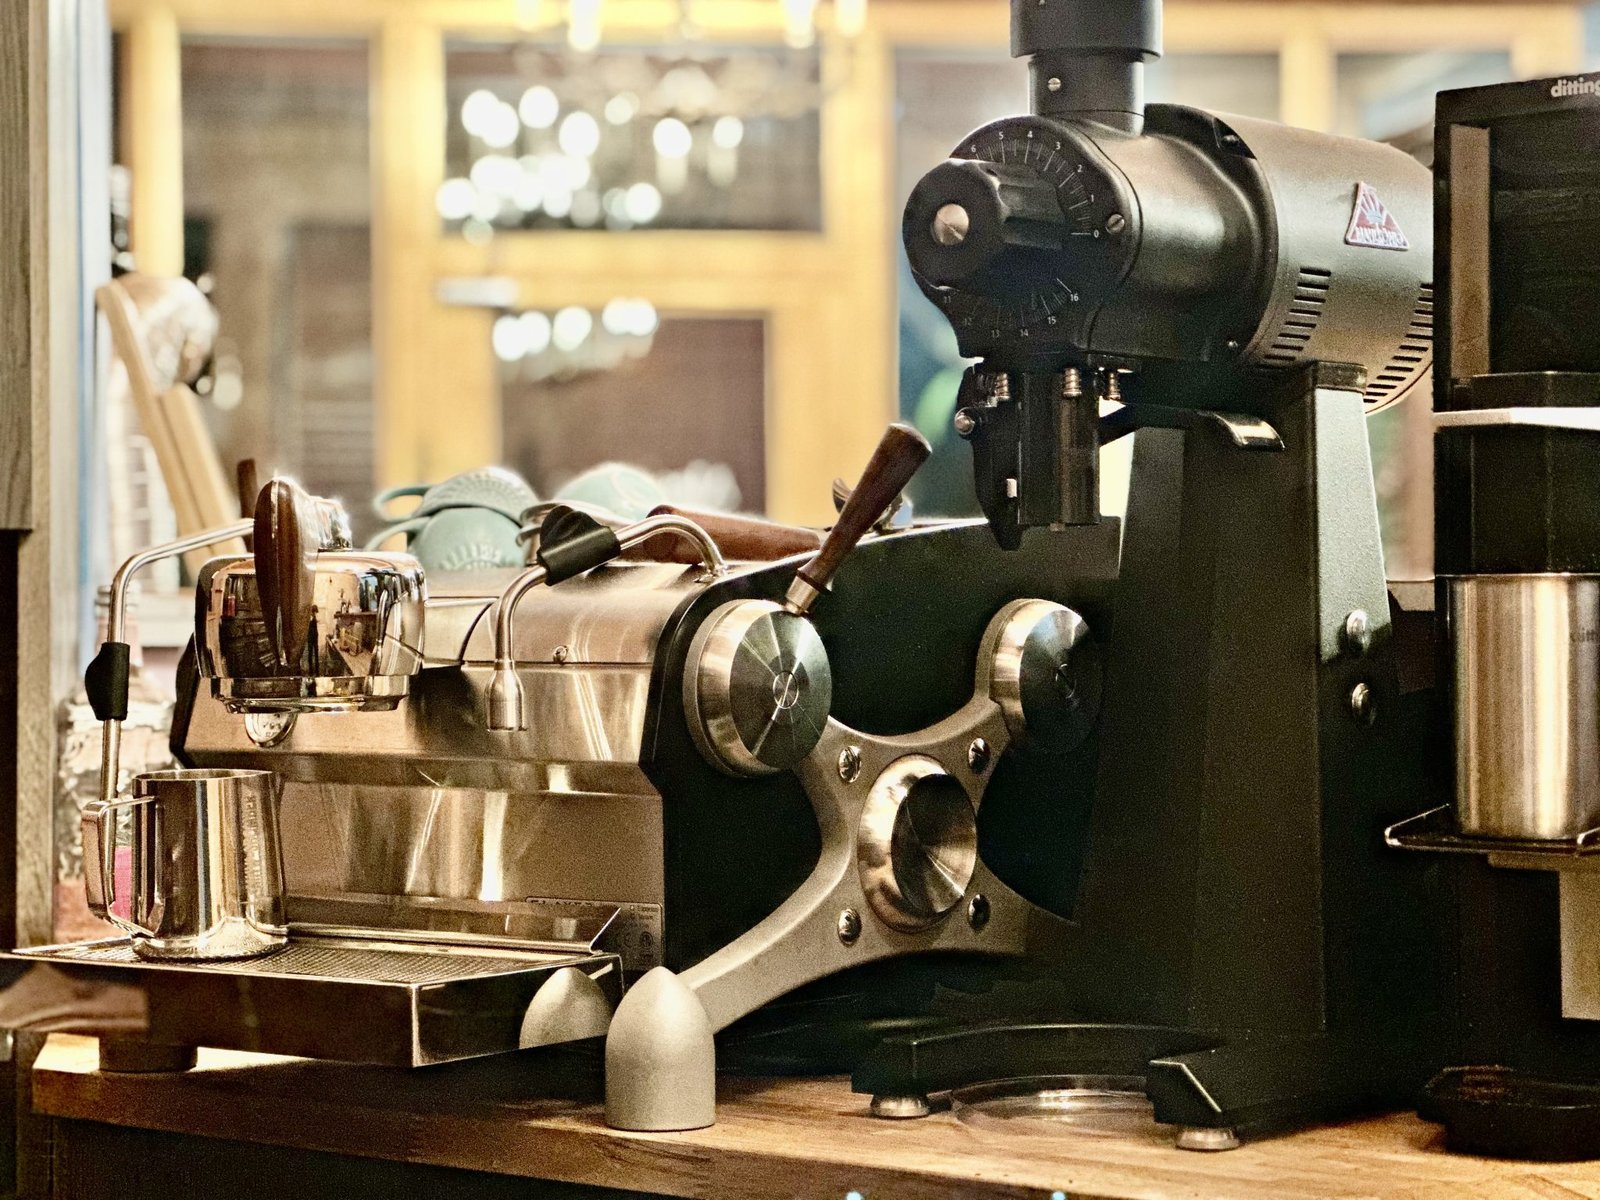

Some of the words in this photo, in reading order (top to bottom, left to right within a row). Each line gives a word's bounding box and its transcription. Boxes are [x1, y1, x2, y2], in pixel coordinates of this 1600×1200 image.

[998, 131, 1004, 140] 5
[1027, 130, 1033, 139] 4
[970, 144, 977, 153] 6
[1055, 141, 1061, 150] 3
[1077, 164, 1083, 173] 2
[1093, 229, 1100, 239] 0
[1070, 293, 1079, 302] 16
[1047, 316, 1057, 325] 15
[990, 329, 1000, 338] 13
[1019, 328, 1029, 337] 14
